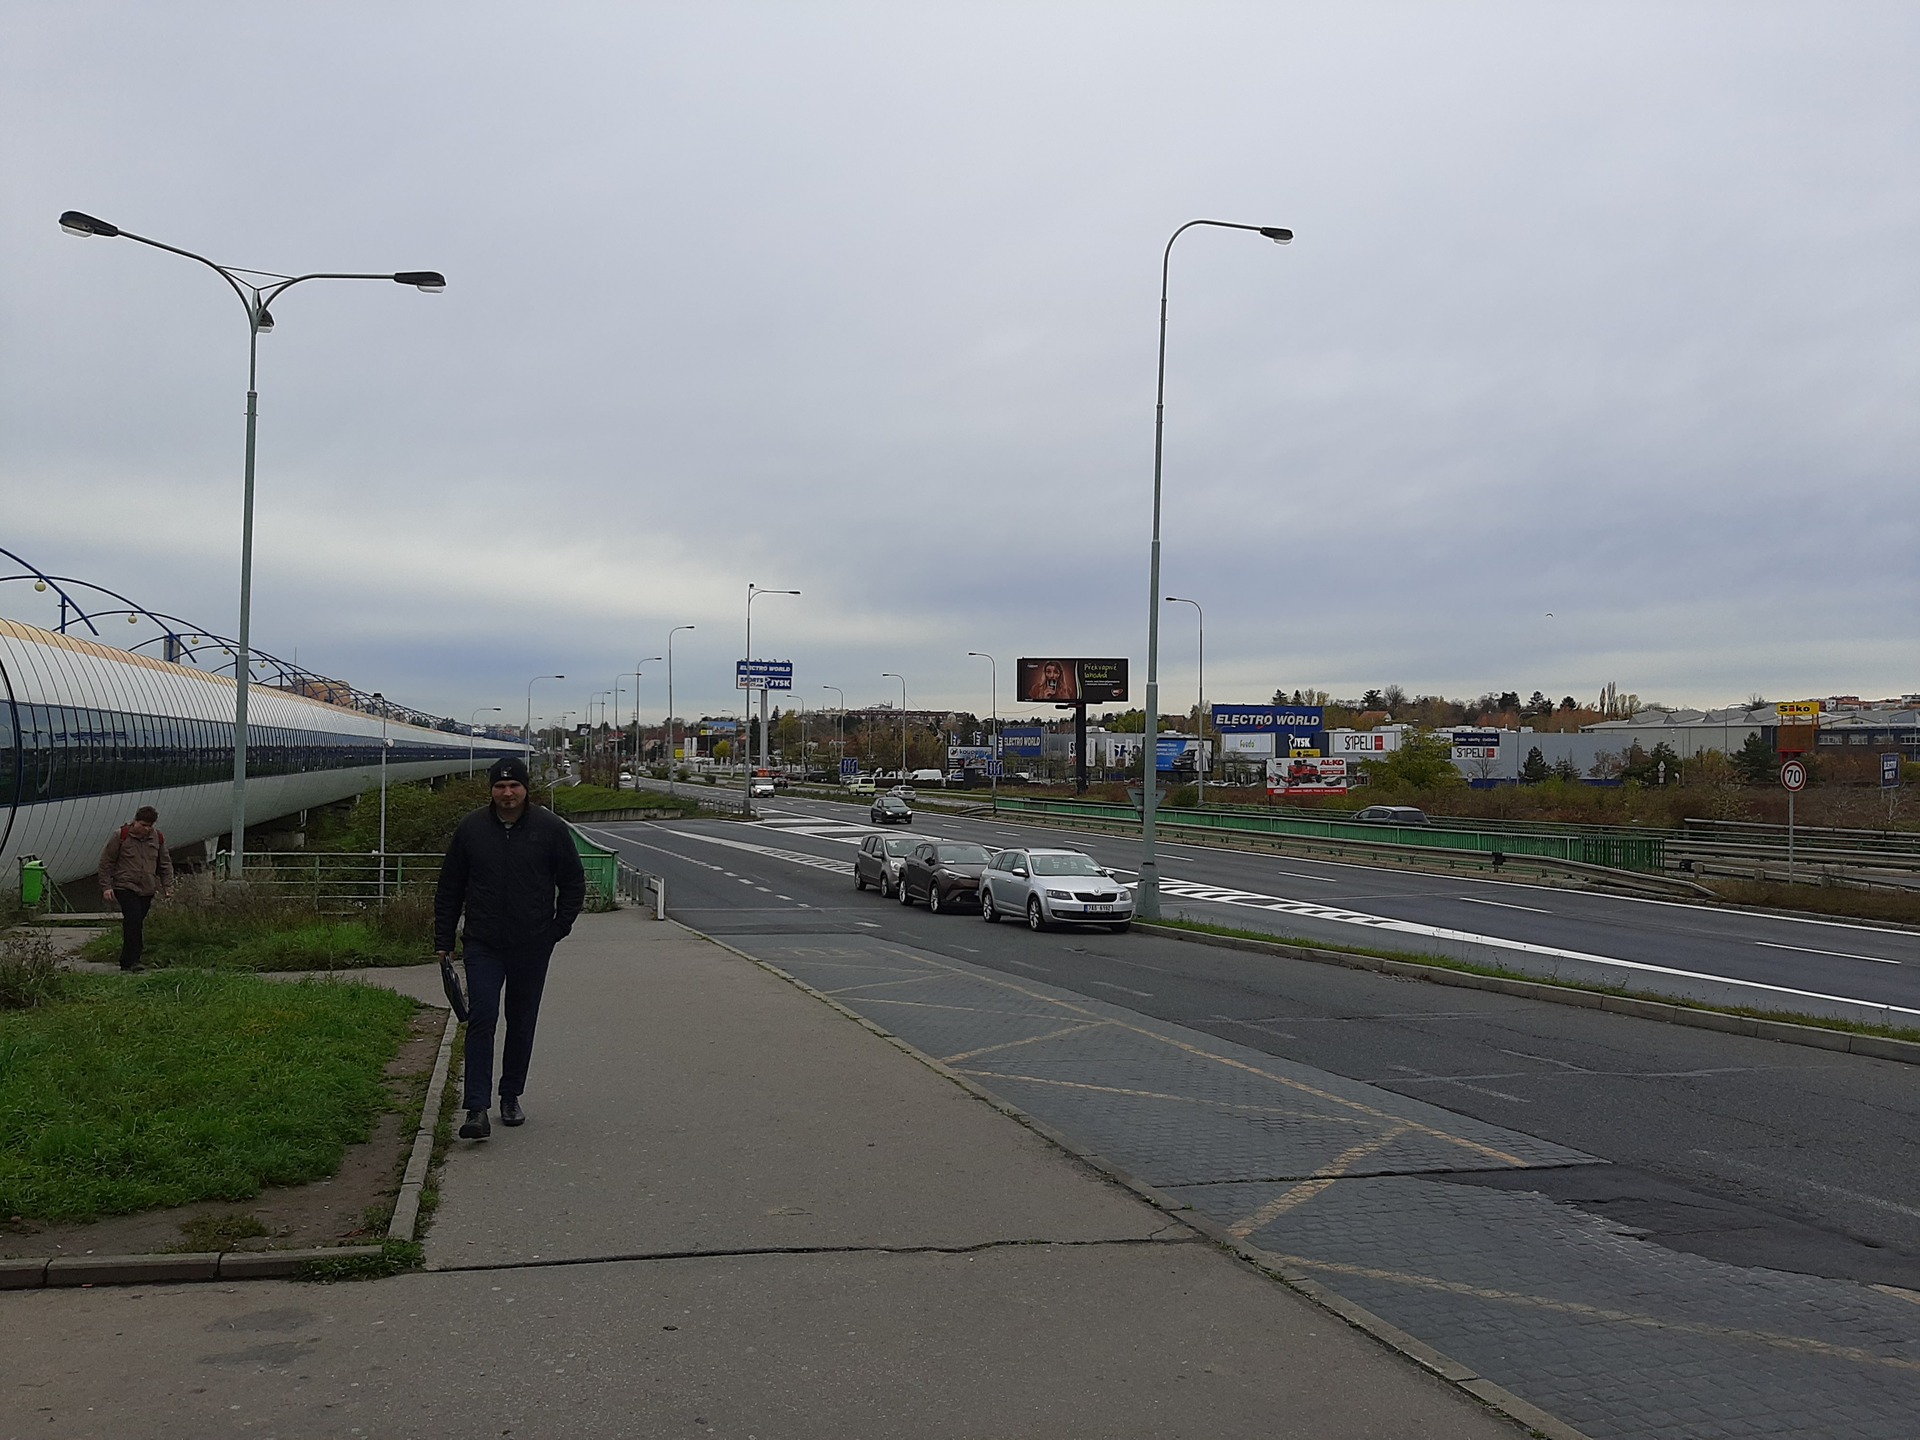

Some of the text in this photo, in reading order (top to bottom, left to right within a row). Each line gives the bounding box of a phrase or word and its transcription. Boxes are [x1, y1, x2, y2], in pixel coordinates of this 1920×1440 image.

[1216, 714, 1320, 726] ELECTRO WORLD
[1004, 737, 1041, 746] ELECTRO WORLD
[1293, 737, 1312, 748] JYSK
[1787, 770, 1801, 783] 70
